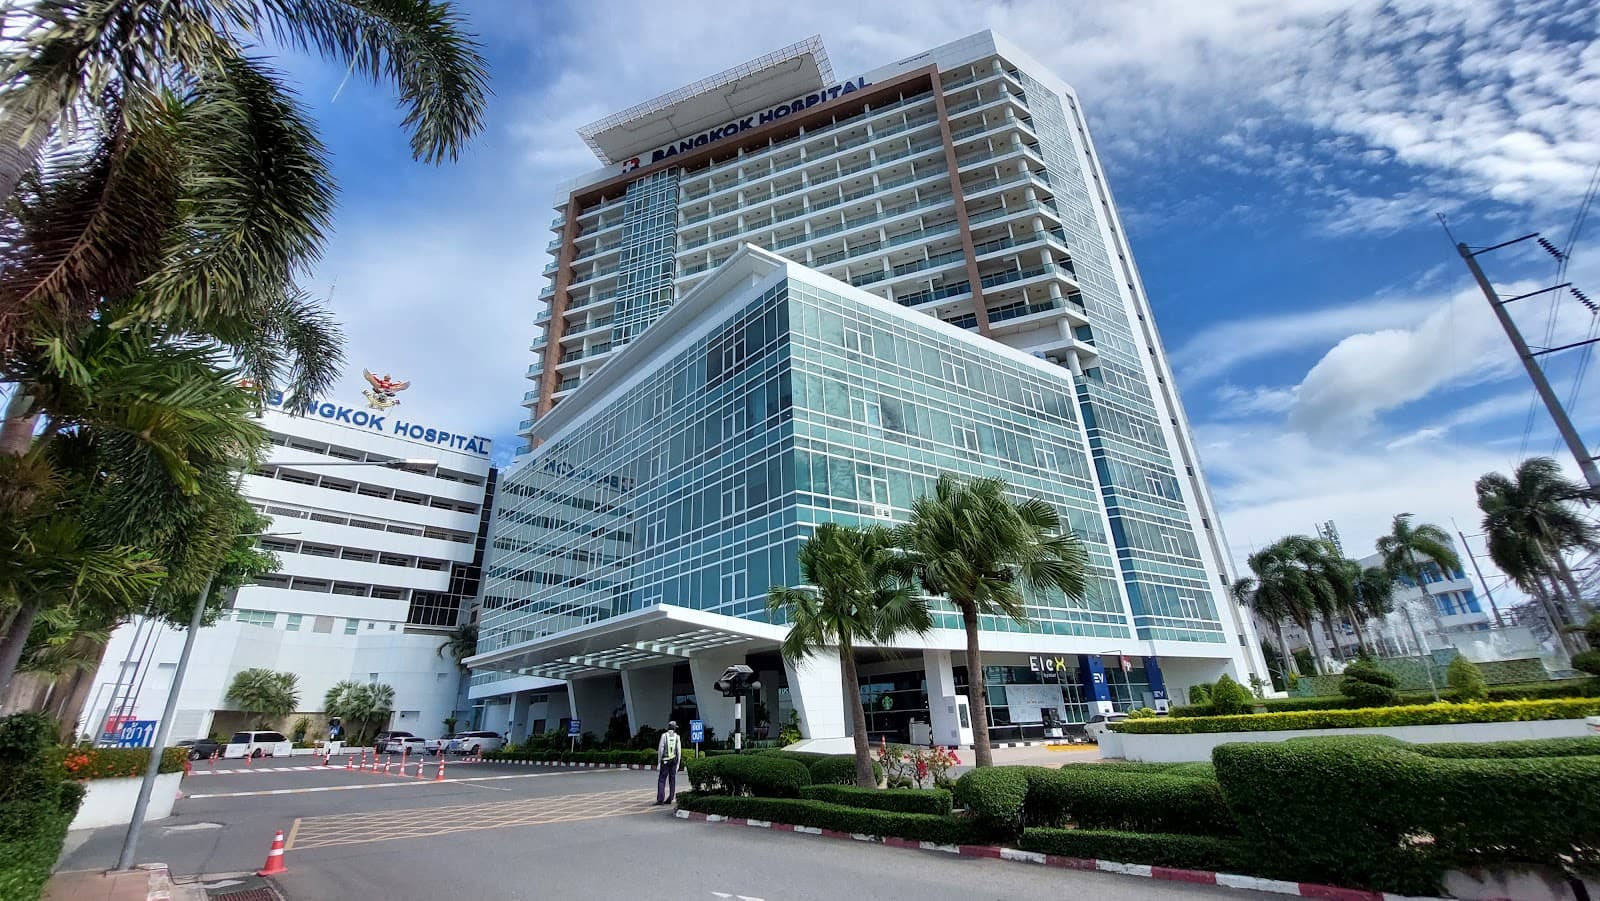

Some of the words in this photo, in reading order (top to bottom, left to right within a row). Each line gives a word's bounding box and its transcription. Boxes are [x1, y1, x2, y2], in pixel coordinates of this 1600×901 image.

[651, 116, 754, 164] BANGKOK
[759, 76, 872, 126] HOSPITAL
[267, 390, 385, 431] BNGKOK
[394, 420, 489, 455] HOSPITAL
[1093, 672, 1104, 684] EV
[120, 721, 143, 740] เข้า
[692, 731, 703, 741] OUT
